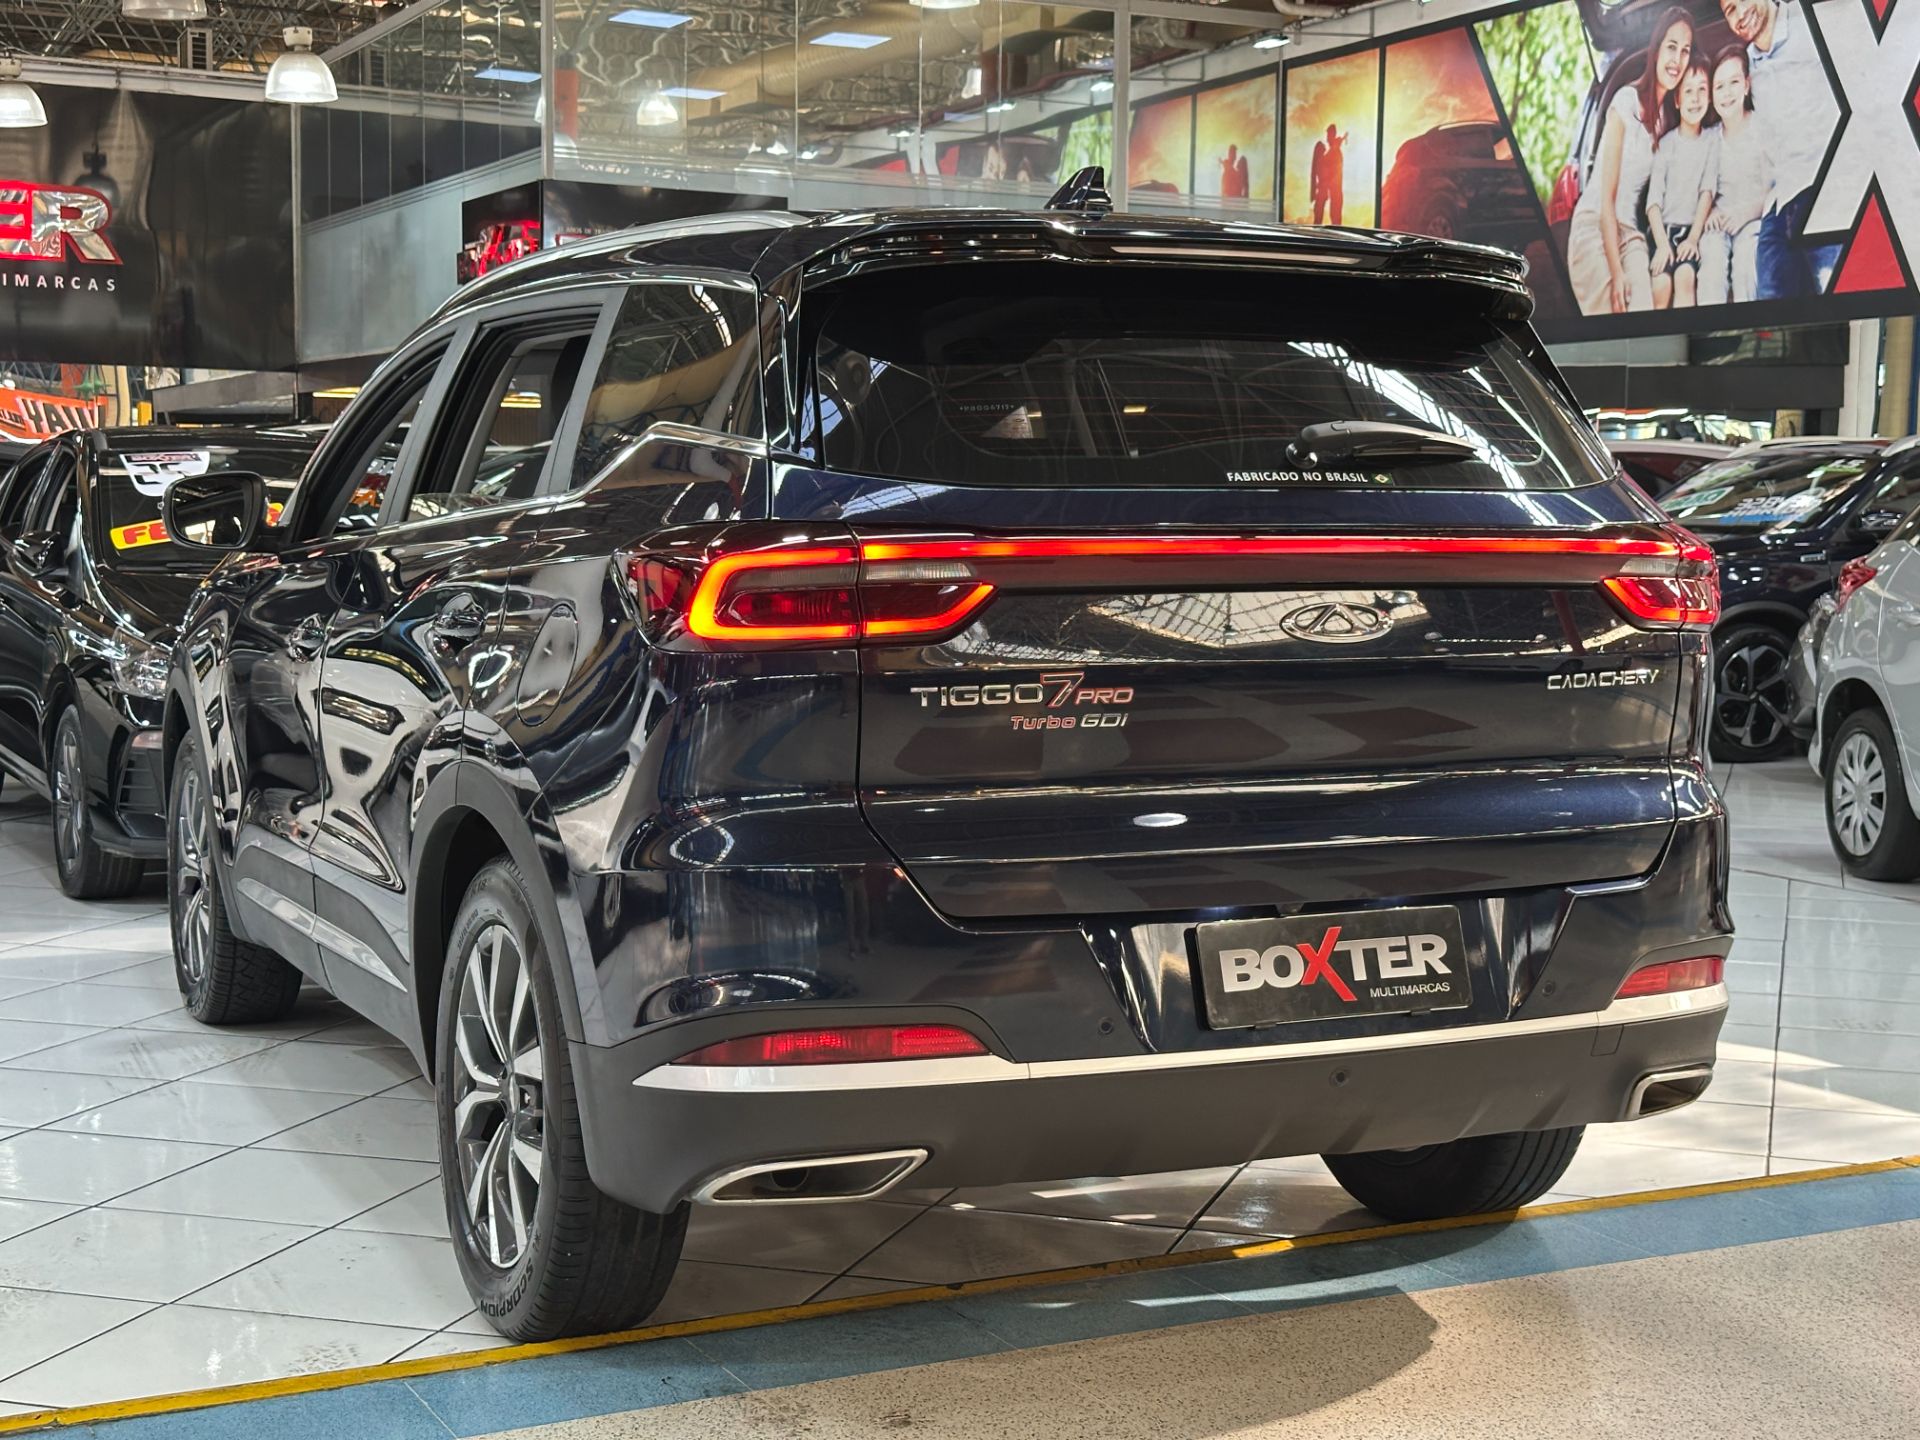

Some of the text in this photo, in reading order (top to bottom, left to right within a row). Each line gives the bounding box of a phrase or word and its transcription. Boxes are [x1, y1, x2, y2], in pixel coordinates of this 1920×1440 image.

[1227, 471, 1368, 483] FABRICADO NO BRASIL
[1011, 715, 1076, 730] Turbo
[1219, 926, 1453, 1002] BOXTER
[1370, 982, 1451, 998] MULTIMARCAS
[480, 1257, 534, 1318] SCORPION
